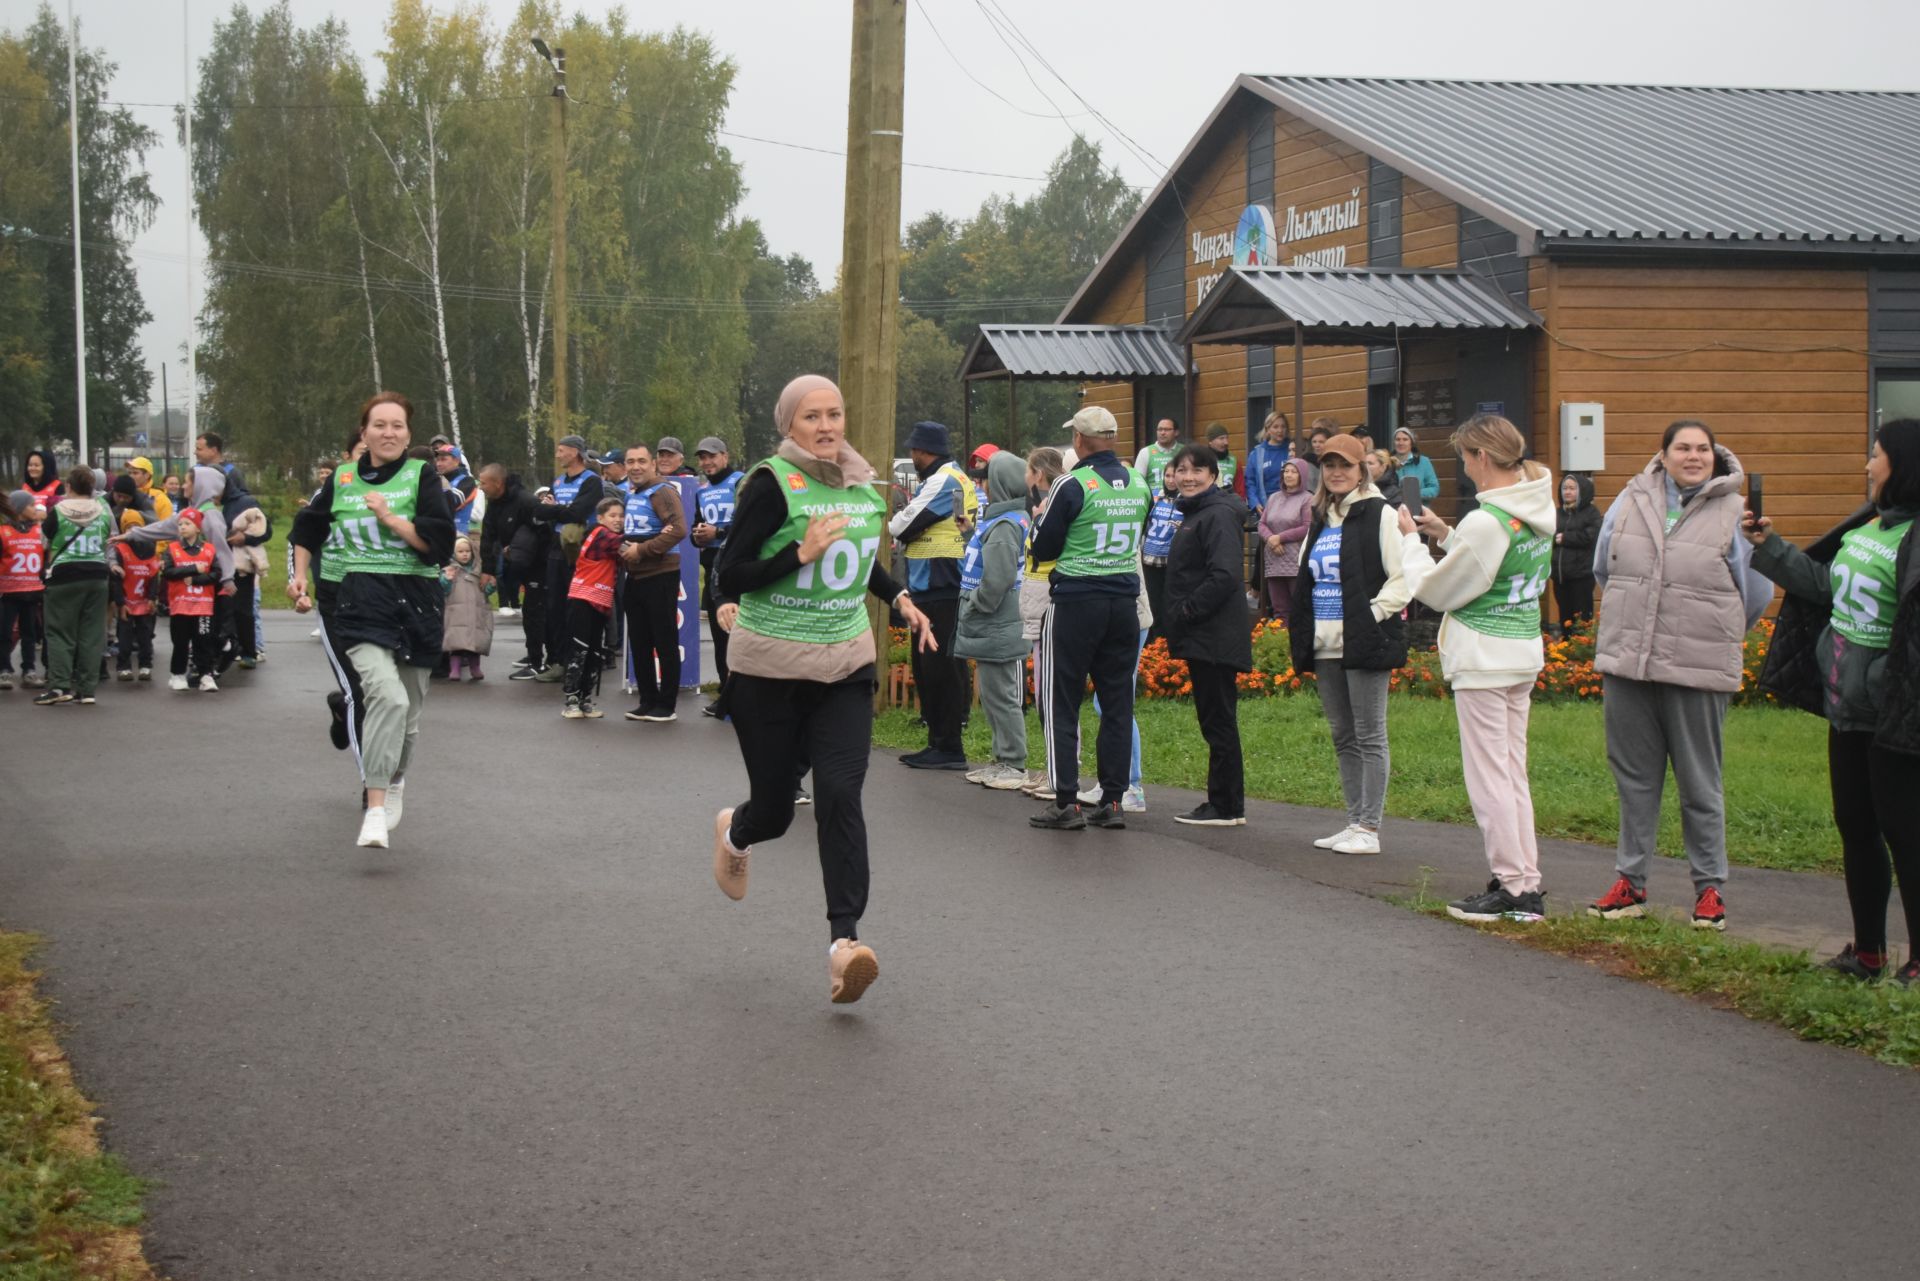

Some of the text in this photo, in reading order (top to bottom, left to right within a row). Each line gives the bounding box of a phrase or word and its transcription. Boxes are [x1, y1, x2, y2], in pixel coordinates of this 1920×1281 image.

[1282, 186, 1360, 244] Лыжный
[1094, 497, 1145, 508] ТУКАЕВСКИЙ
[1107, 506, 1137, 516] РАЙОН
[700, 503, 735, 524] 07
[10, 552, 42, 574] 20
